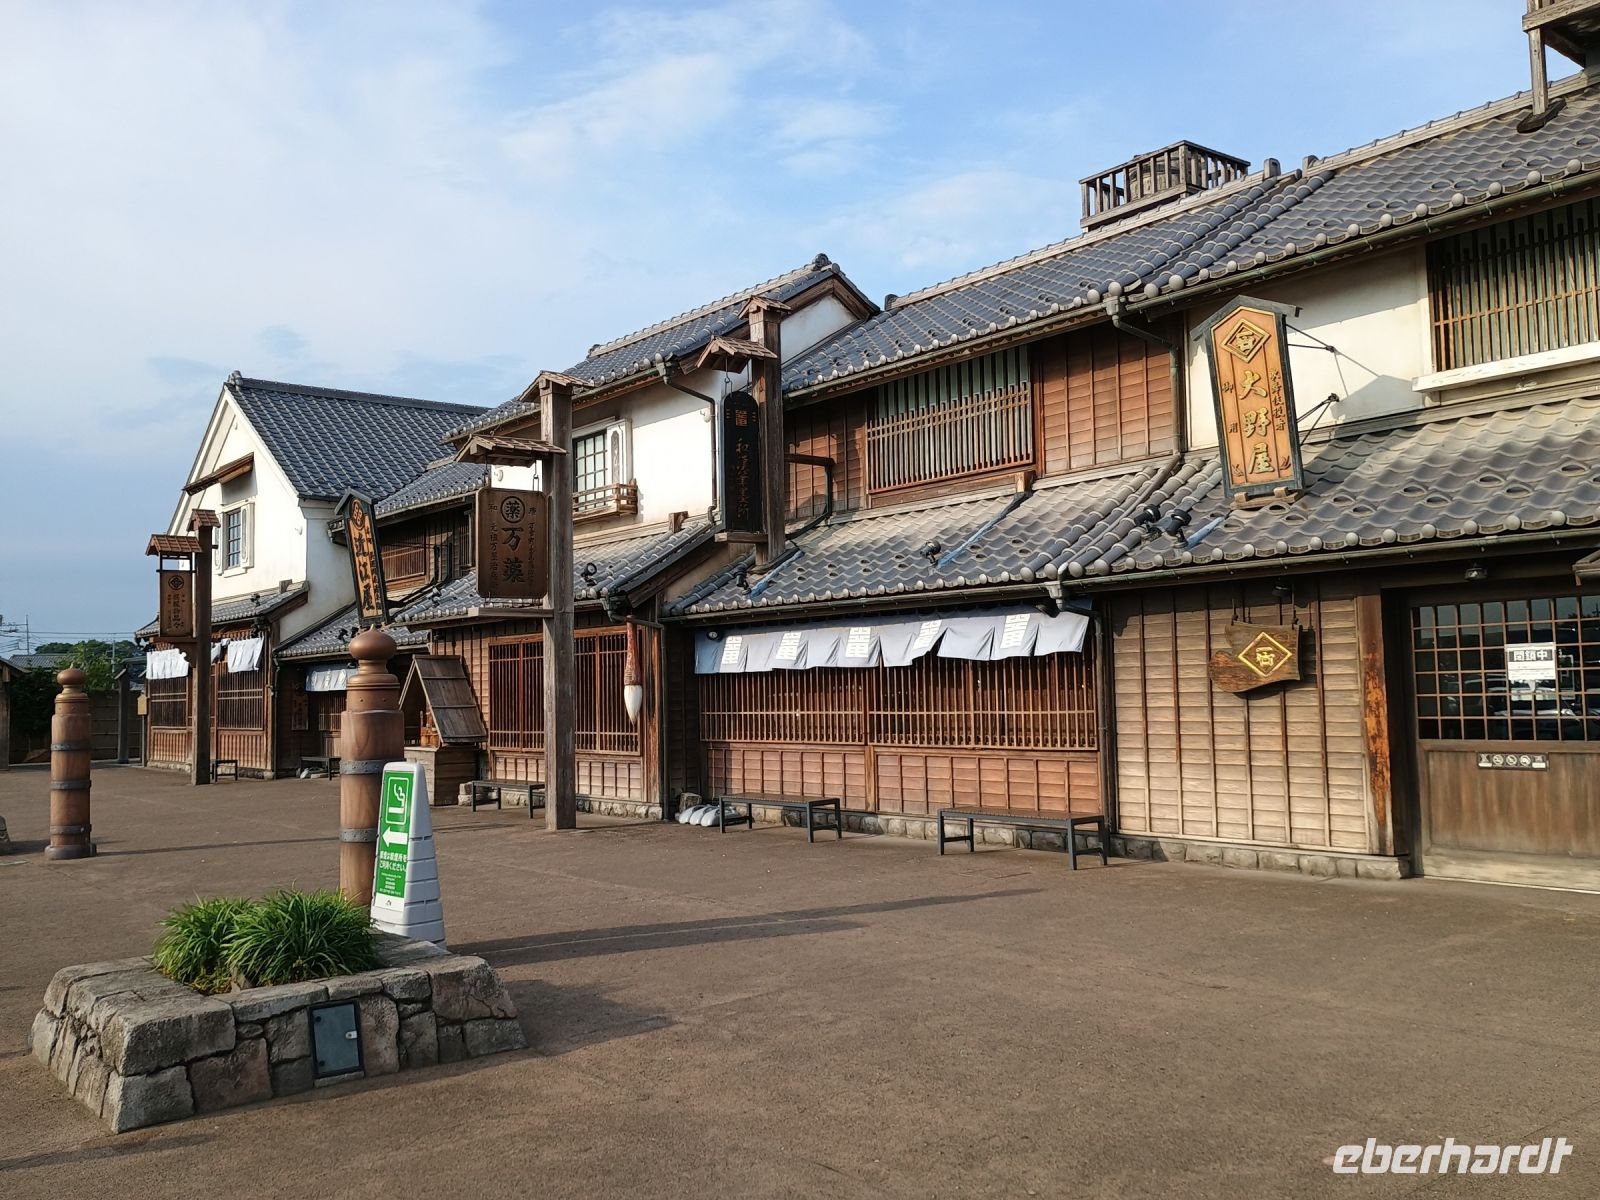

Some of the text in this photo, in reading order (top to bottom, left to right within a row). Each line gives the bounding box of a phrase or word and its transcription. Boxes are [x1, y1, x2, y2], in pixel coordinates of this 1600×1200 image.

[1238, 369, 1275, 475] 大野屋
[1513, 649, 1548, 662] 閉鎖中
